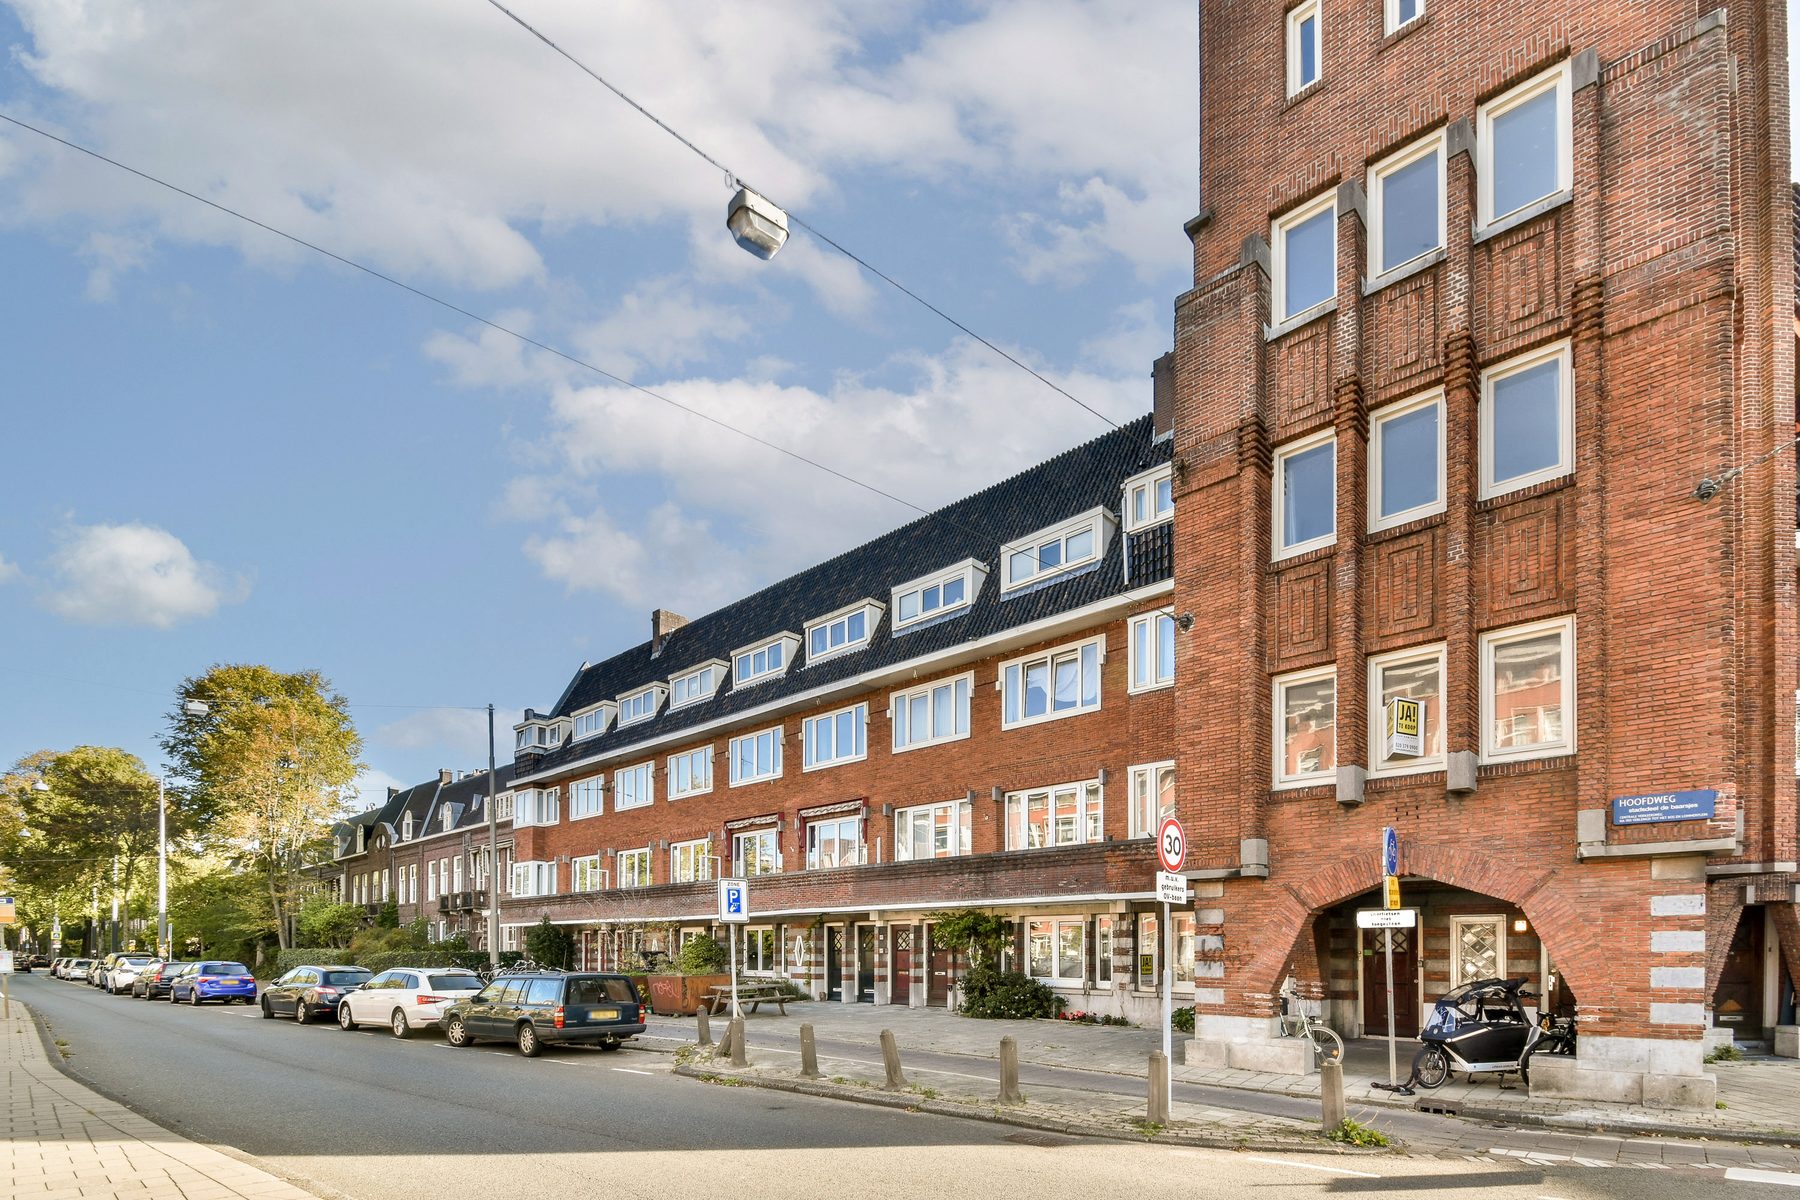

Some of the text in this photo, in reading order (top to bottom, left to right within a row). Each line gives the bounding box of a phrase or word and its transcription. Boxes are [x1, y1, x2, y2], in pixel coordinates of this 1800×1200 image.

[1400, 705, 1415, 722] JA!
[1619, 795, 1676, 807] HOOFDWEG
[1165, 834, 1181, 856] 30
[1161, 884, 1184, 892] gebruikers
[729, 890, 738, 903] P
